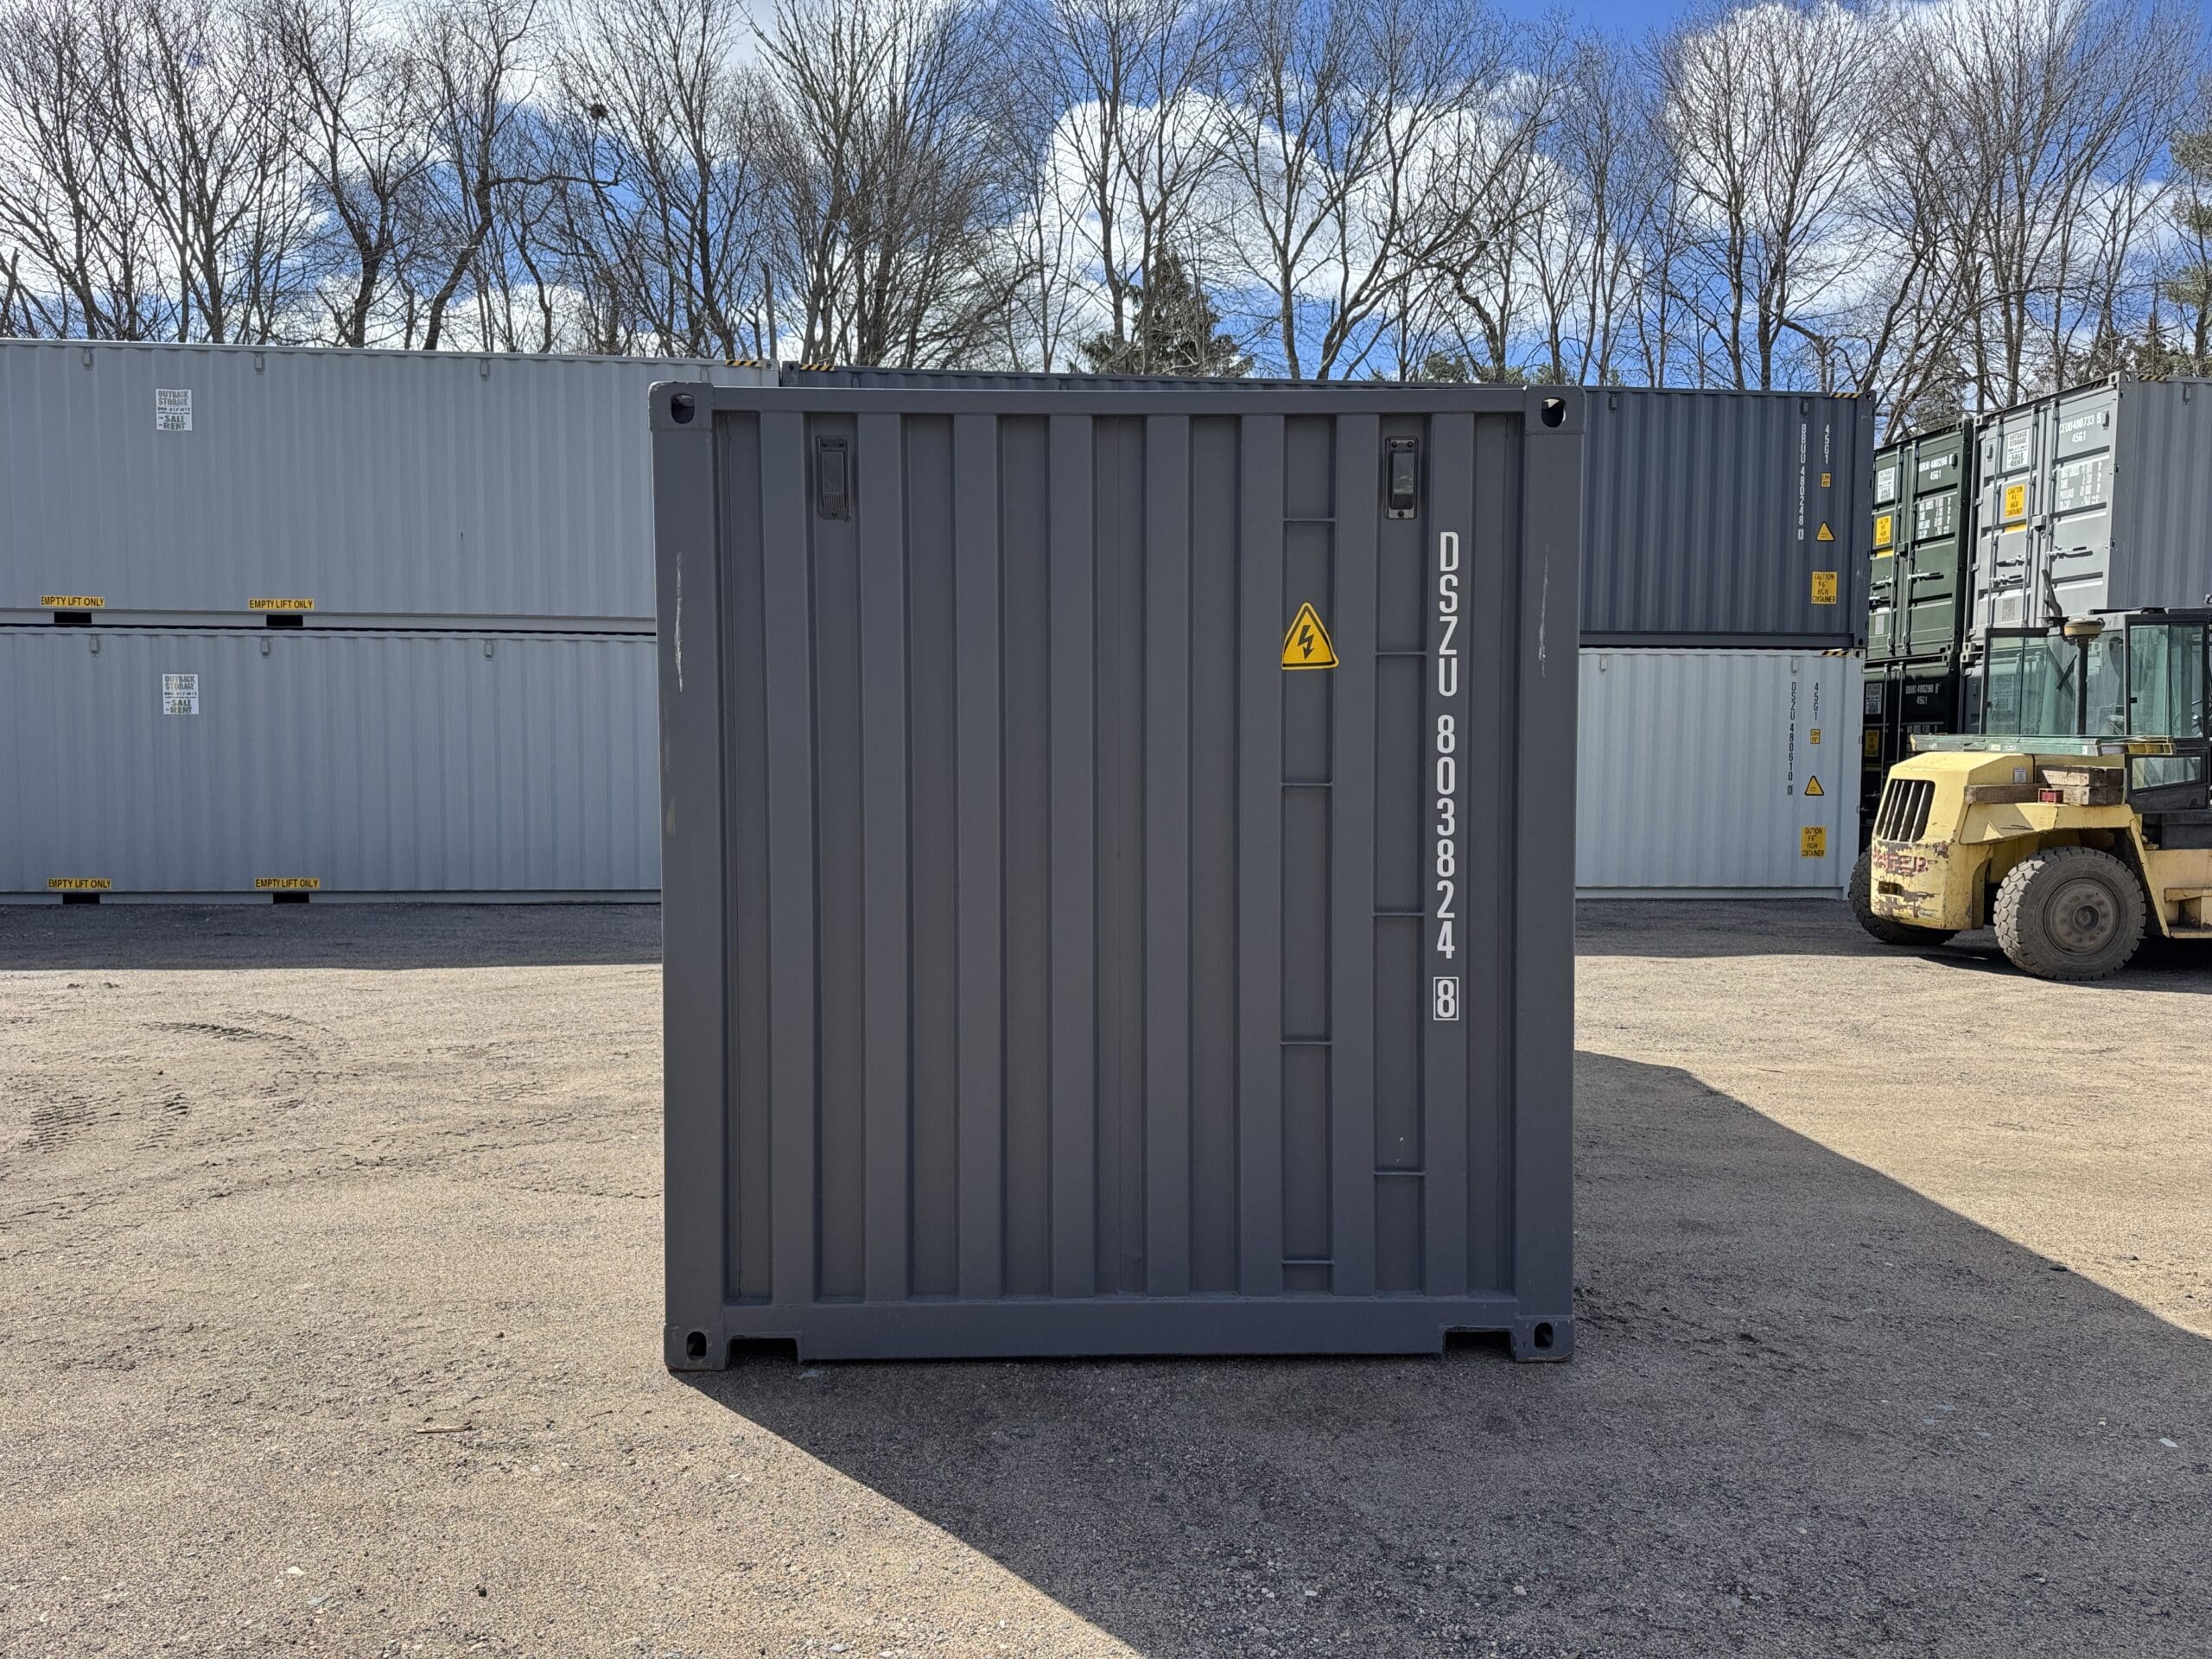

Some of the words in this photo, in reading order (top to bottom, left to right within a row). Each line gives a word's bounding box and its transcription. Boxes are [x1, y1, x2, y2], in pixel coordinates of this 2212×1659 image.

[2071, 431, 2087, 443] 45G1
[41, 596, 67, 606] EMPTY
[68, 596, 82, 607] LIFT
[83, 597, 105, 607] ONLY
[249, 600, 274, 608] EMPTY
[276, 600, 292, 608] LIFT
[294, 600, 313, 608] ONLY
[1438, 531, 1459, 697] DSZU
[1436, 714, 1456, 960] 803824
[48, 879, 73, 888] EMPTY
[75, 879, 90, 888] LIFT
[91, 879, 111, 888] ONLY
[255, 878, 280, 888] EMPTY
[282, 878, 298, 888] LIFT
[300, 878, 319, 888] ONLY
[1436, 979, 1456, 1018] 8
